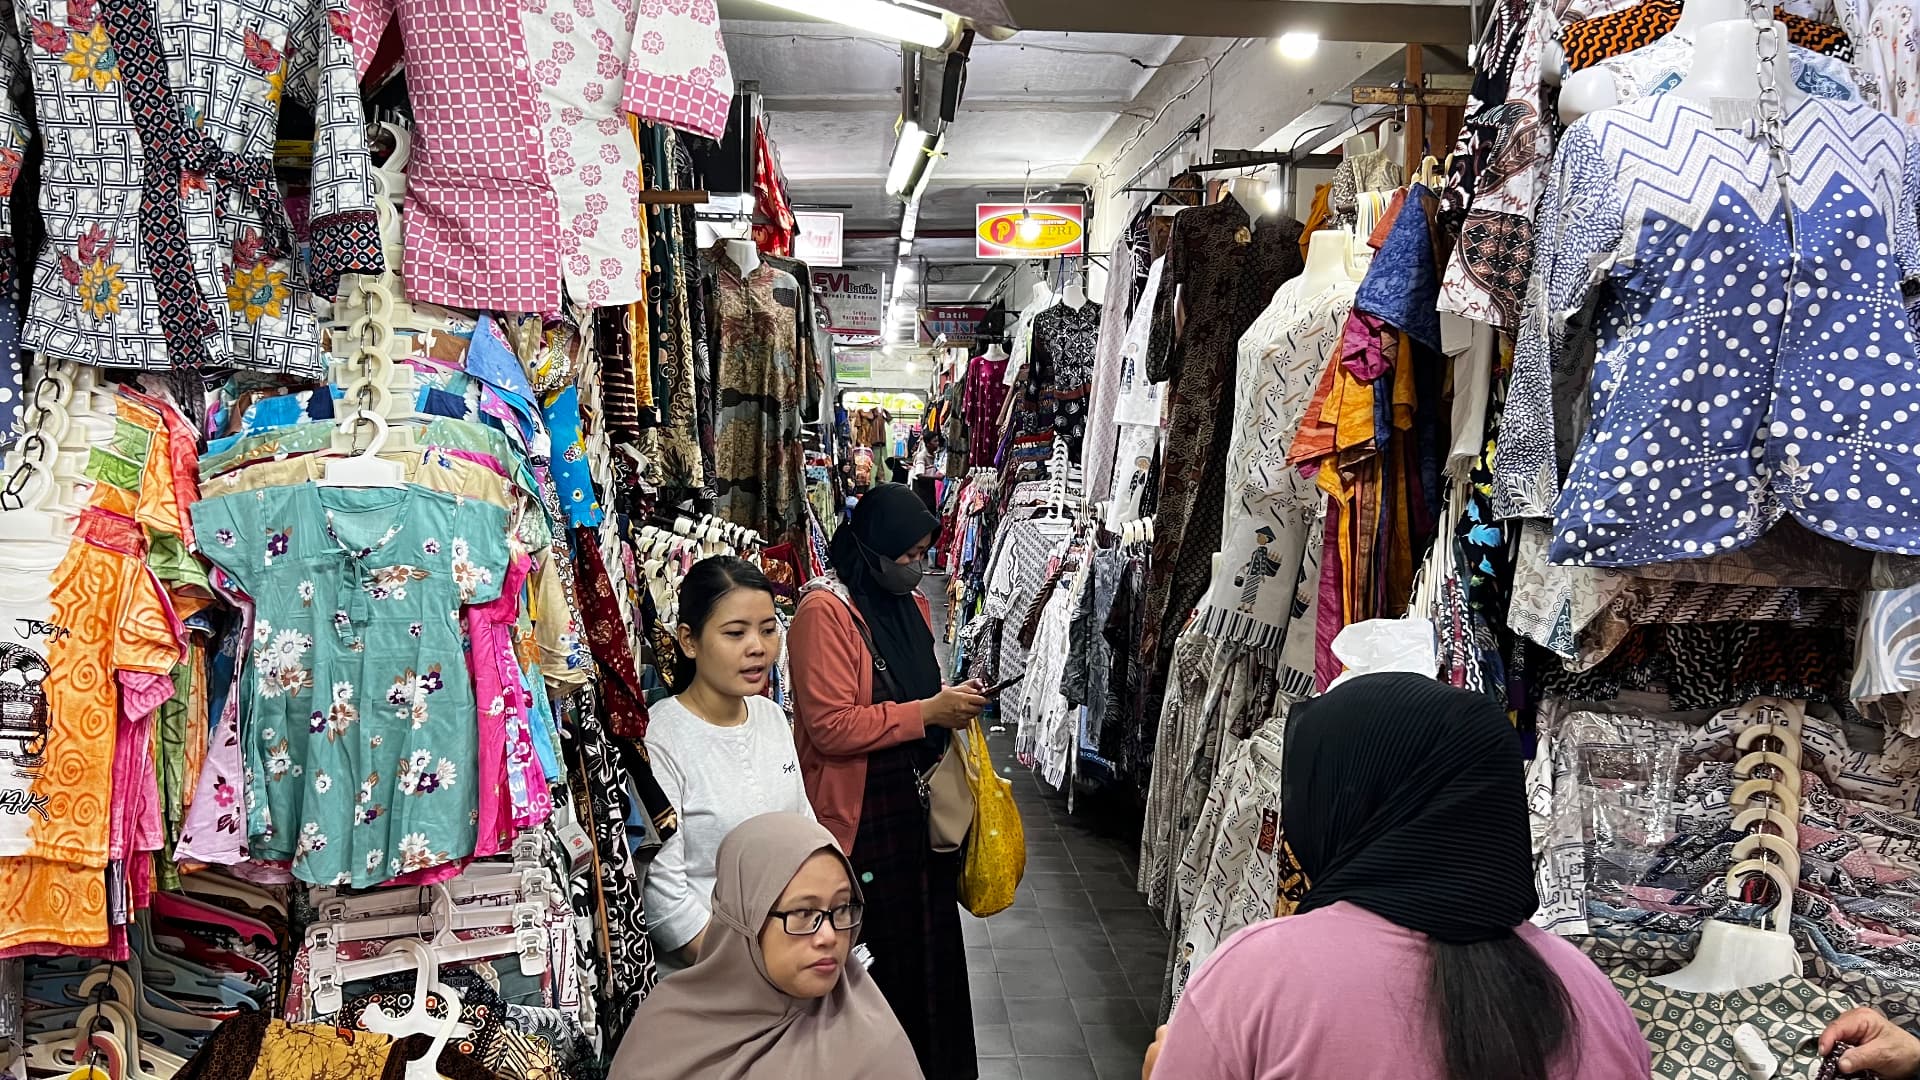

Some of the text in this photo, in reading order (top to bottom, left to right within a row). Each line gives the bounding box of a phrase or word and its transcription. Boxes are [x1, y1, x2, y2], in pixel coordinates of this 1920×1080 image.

[848, 283, 878, 295] Batik
[938, 311, 969, 319] Batik
[0, 788, 50, 822] AK
